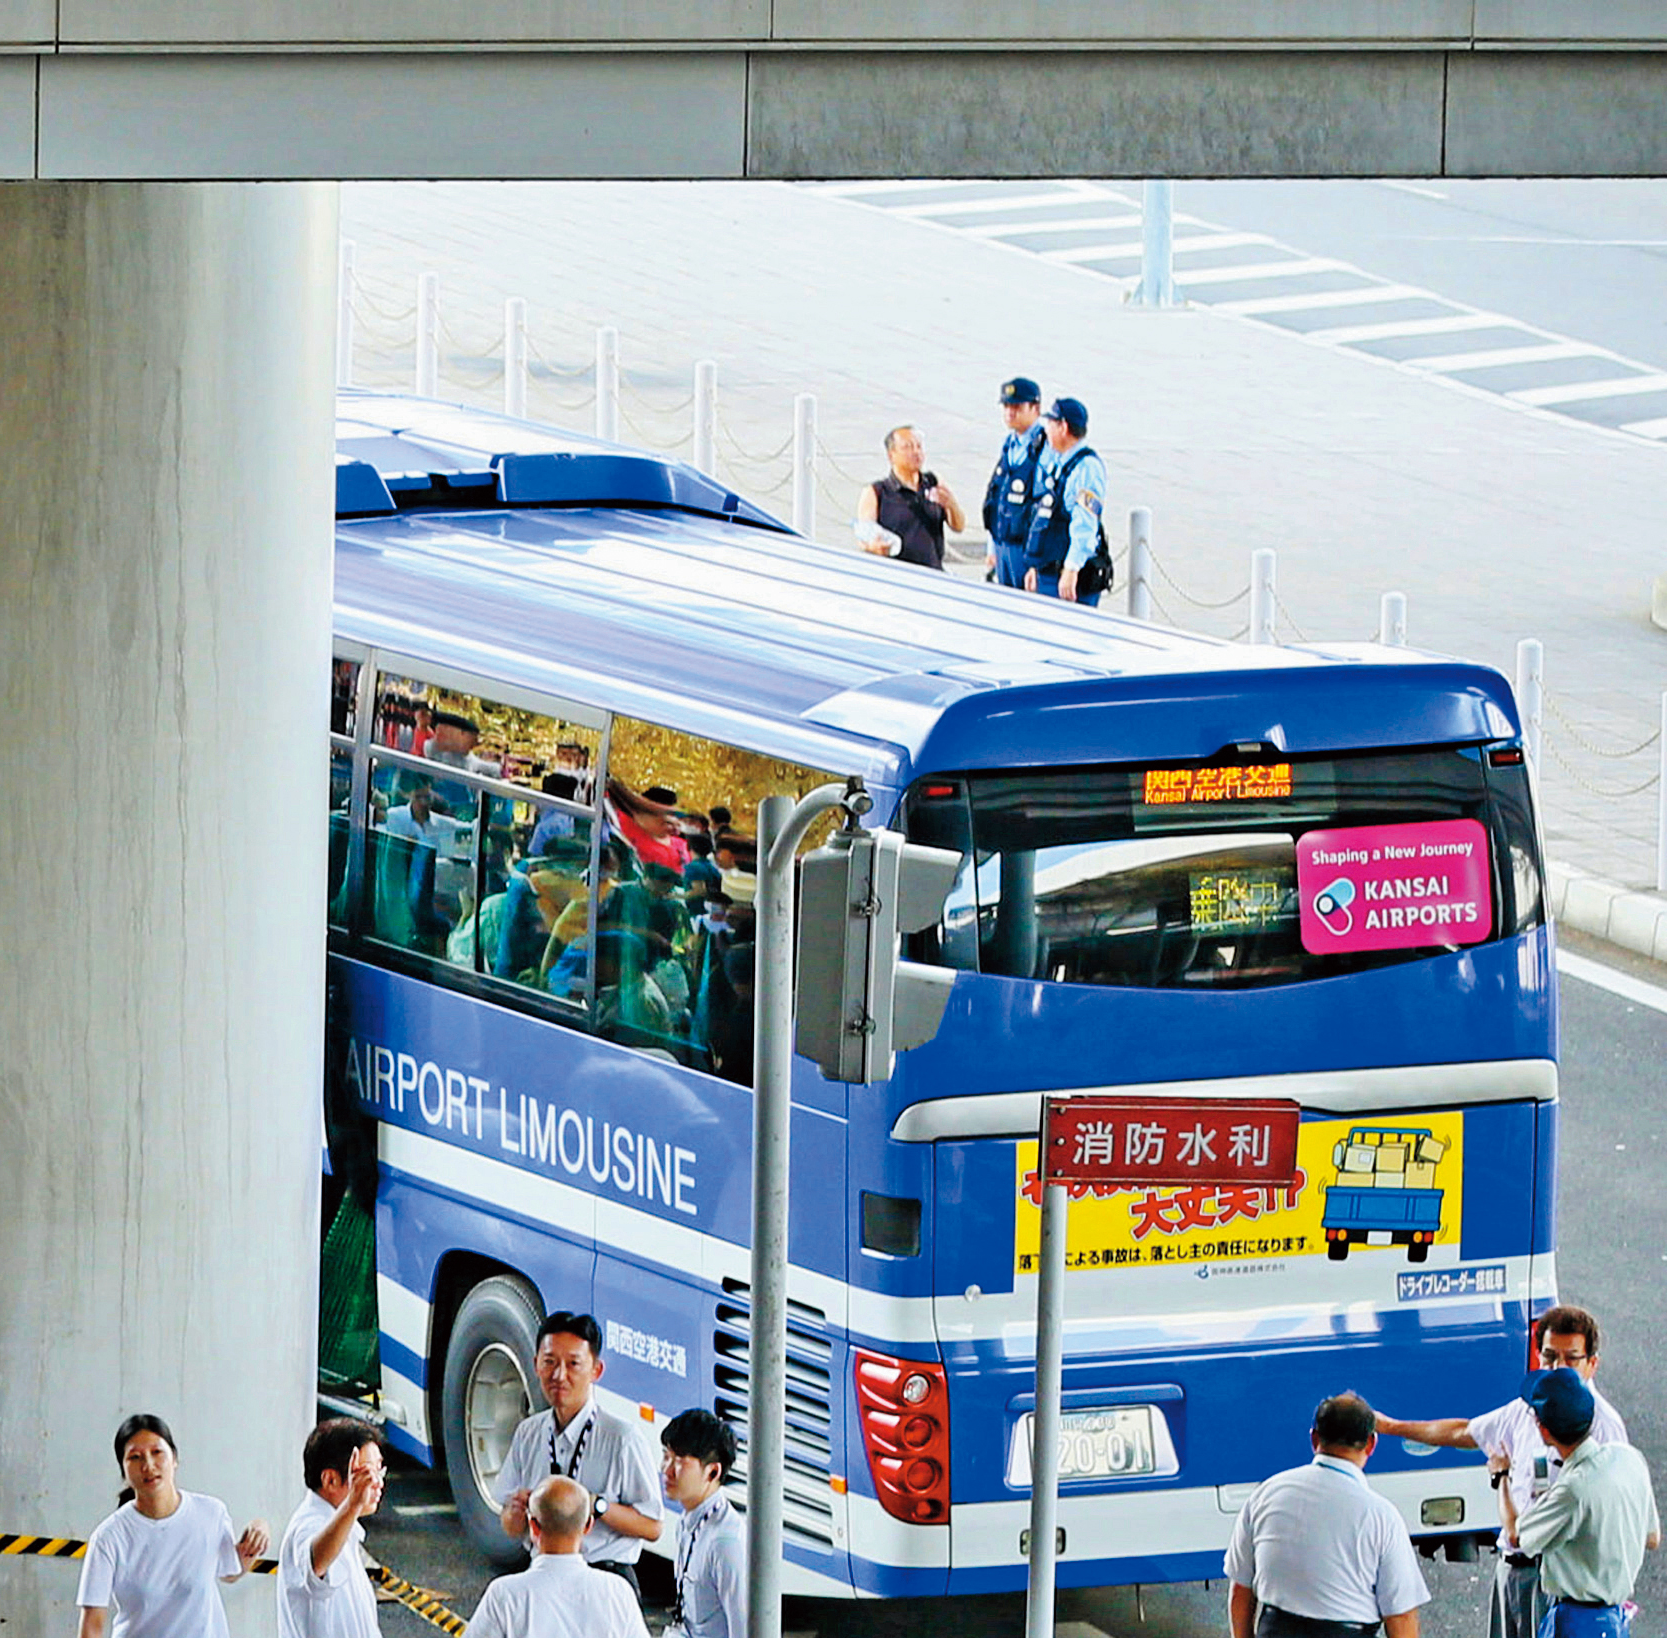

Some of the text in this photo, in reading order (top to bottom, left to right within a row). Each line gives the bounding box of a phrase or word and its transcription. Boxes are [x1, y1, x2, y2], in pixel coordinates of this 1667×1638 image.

[1144, 764, 1292, 790] 関西空港交通
[1190, 784, 1232, 803] Airport
[1236, 781, 1292, 799] Limousine
[1312, 841, 1474, 867] Shaping a New Journey
[1364, 876, 1449, 902] KANSAI
[1365, 902, 1477, 930] AIRPORTS
[347, 1038, 697, 1216] AIRPORT LIMOUSINE
[1072, 1120, 1271, 1167] 消防水利
[606, 1319, 687, 1379] 関西空港交通
